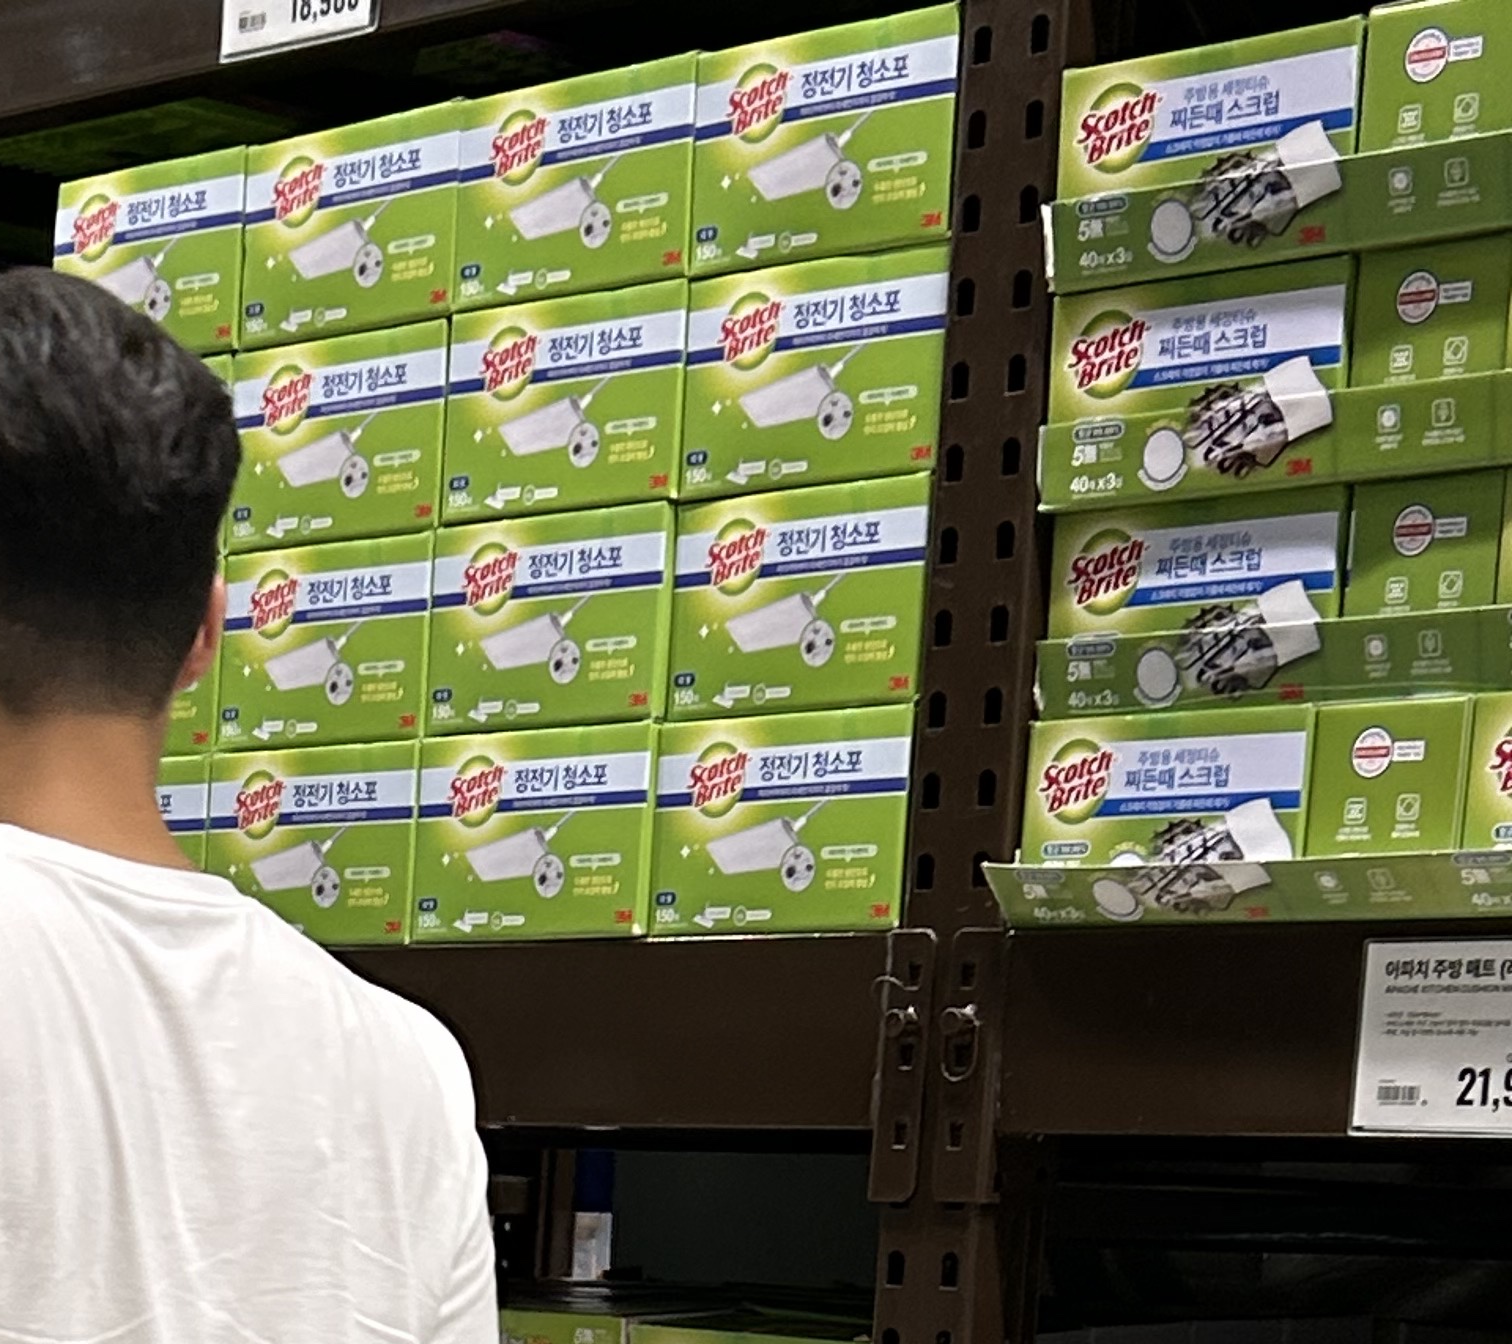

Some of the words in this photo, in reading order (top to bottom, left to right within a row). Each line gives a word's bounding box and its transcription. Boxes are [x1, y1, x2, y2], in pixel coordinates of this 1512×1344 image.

[801, 63, 853, 99] 정전기
[857, 54, 909, 89] 청소포
[556, 109, 603, 143] 정전기
[607, 100, 654, 134] 청소포
[734, 94, 783, 135] Brite
[1226, 89, 1280, 120] 스크럽
[497, 139, 541, 177] Brite
[1085, 118, 1150, 165] Brite
[793, 296, 845, 329] 정전기
[849, 289, 902, 321] 청소포
[547, 331, 594, 361] 정전기
[597, 325, 644, 356] 청소포
[726, 323, 775, 362] Brite
[1214, 324, 1268, 351] 스크럽
[487, 356, 531, 392] Brite
[1076, 347, 1138, 389] Brite
[777, 525, 827, 556] 정전기
[831, 521, 881, 551] 청소포
[528, 549, 574, 578] 정전기
[577, 545, 624, 574] 청소포
[713, 550, 760, 586] Brite
[1210, 548, 1263, 572] 스크럽
[468, 572, 512, 606] Brite
[1075, 564, 1137, 605] Brite
[513, 765, 560, 792] 정전기
[562, 763, 609, 790] 청소포
[759, 752, 809, 780] 정전기
[812, 750, 864, 778] 청소포
[1178, 764, 1231, 788] 스크럽
[455, 786, 498, 818] Brite
[695, 774, 742, 807] Brite
[1046, 777, 1106, 813] Brite
[1432, 959, 1462, 979] 주방
